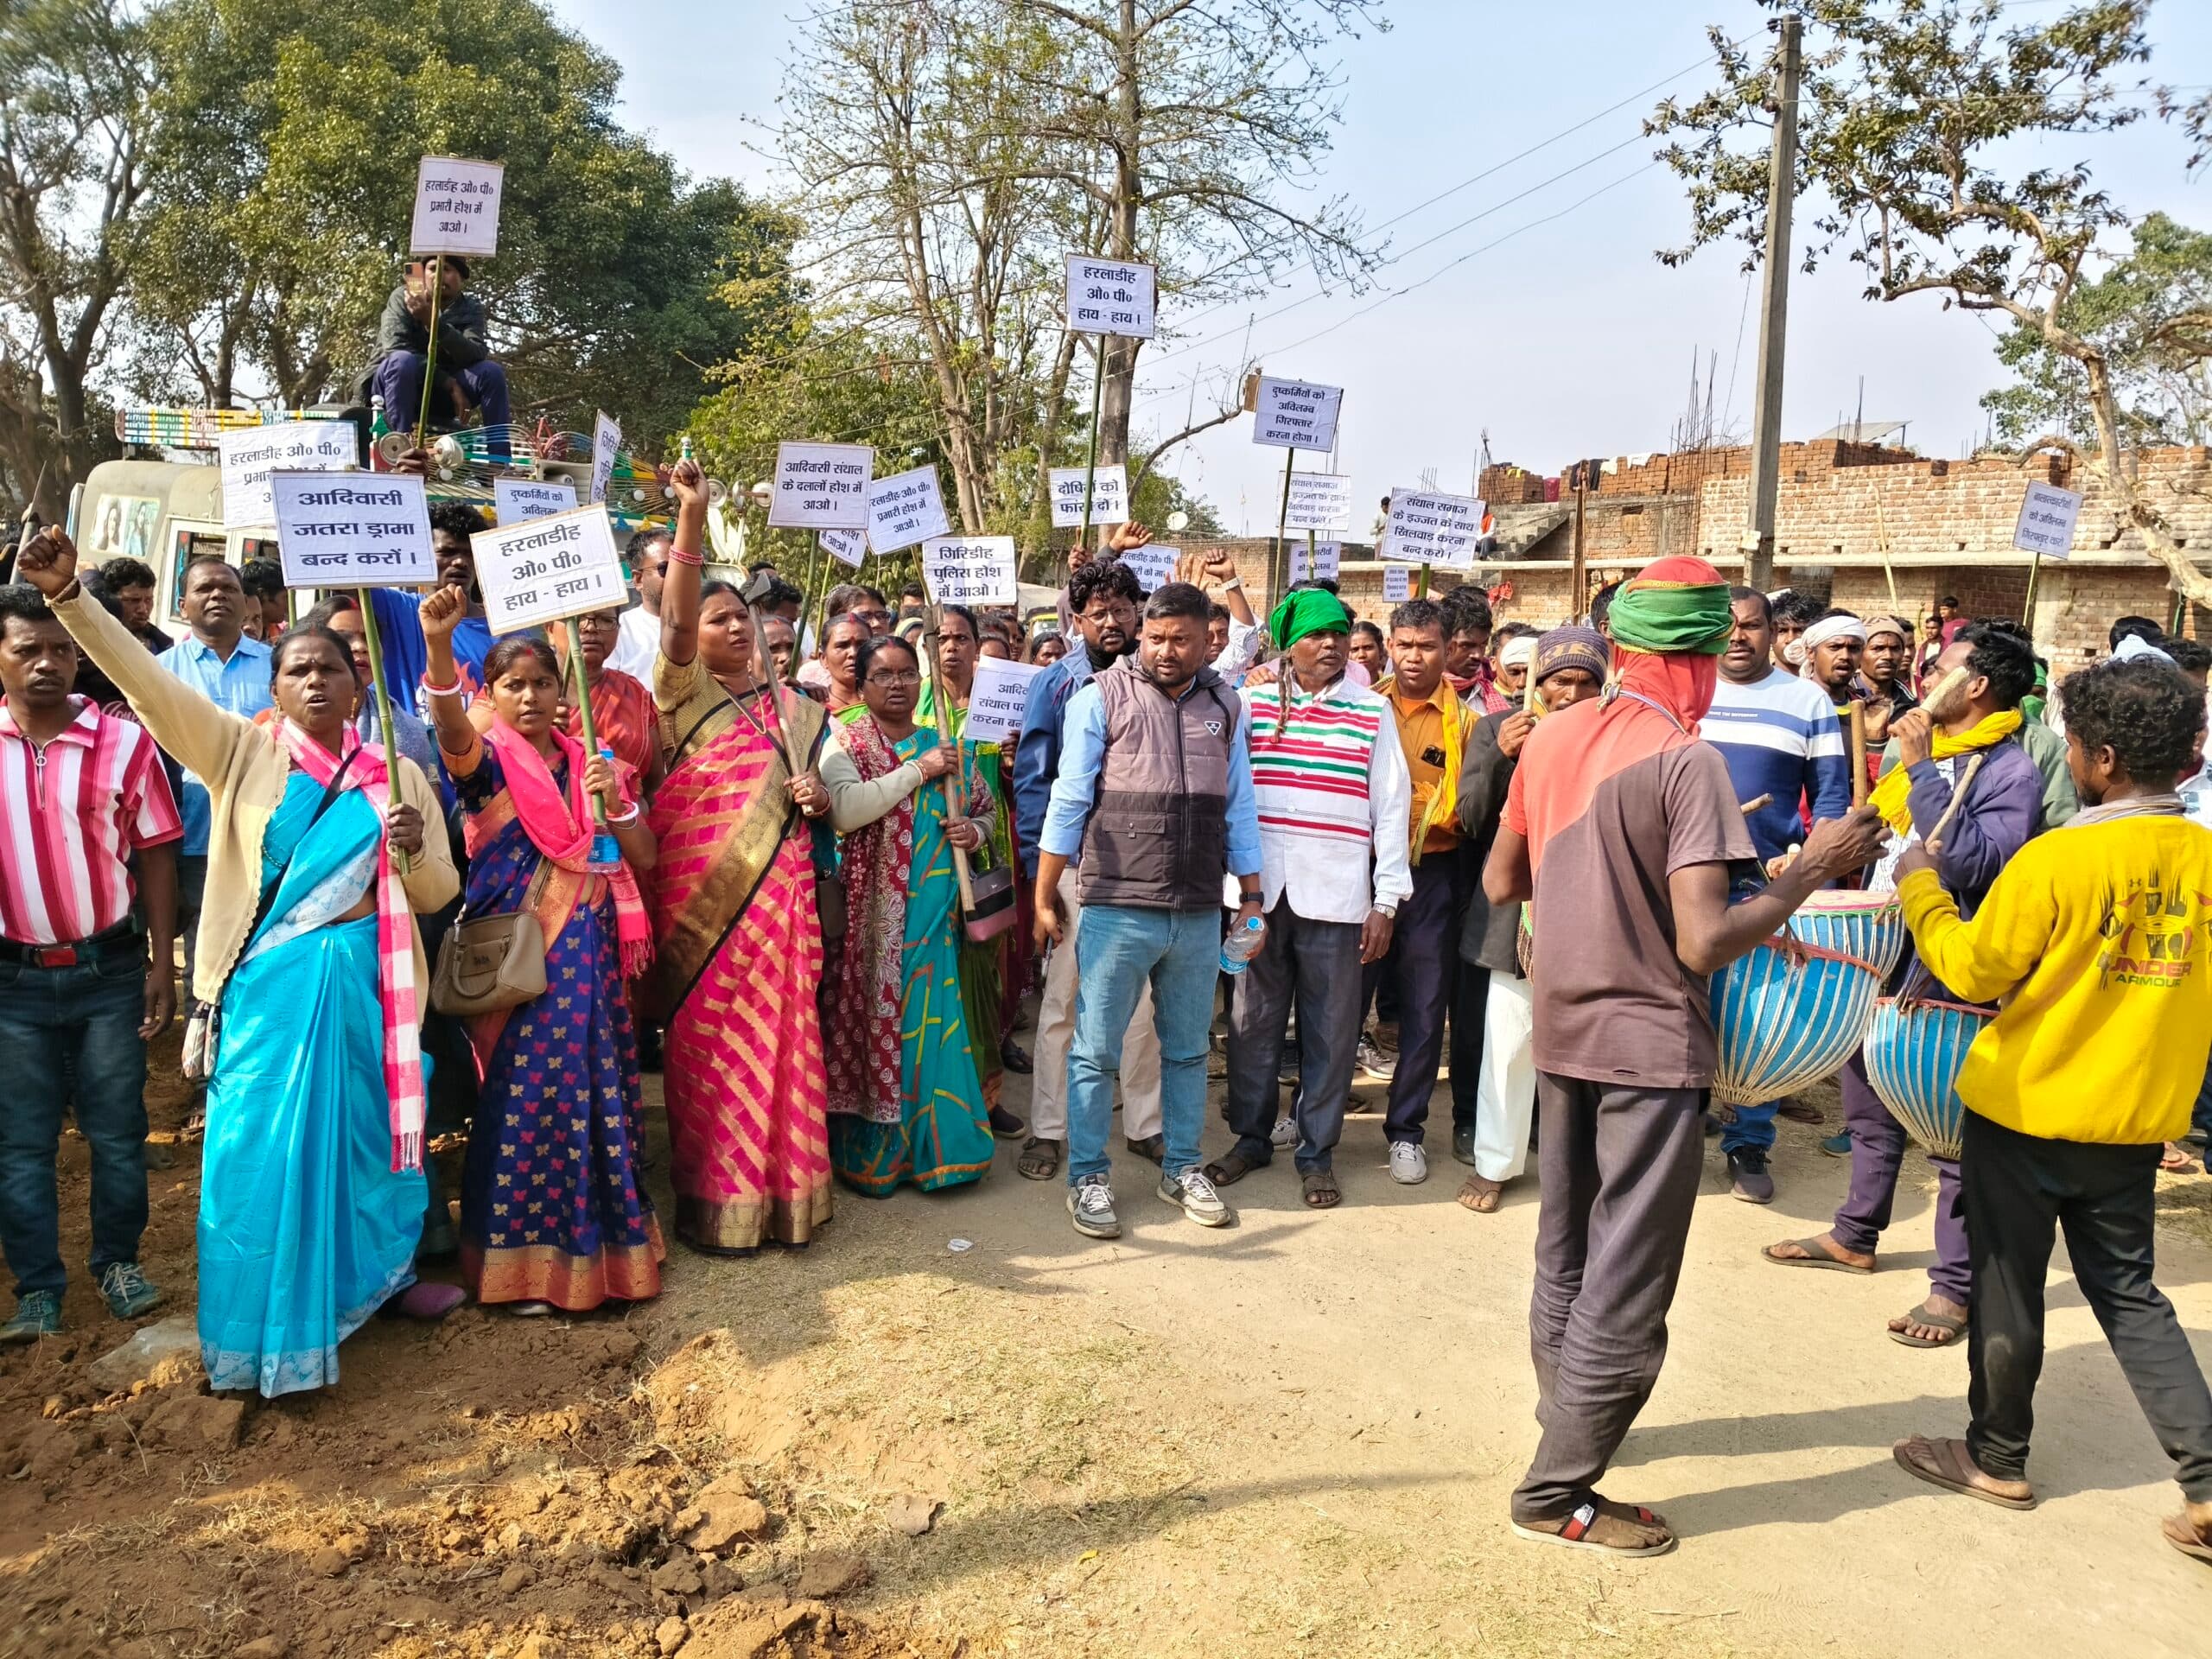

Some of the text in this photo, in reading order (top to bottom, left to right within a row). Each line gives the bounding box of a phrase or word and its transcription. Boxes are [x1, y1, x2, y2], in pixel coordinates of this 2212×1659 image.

[429, 198, 483, 214] प्रभारी होश में
[1084, 266, 1136, 284] हरलाडीह
[1078, 308, 1099, 320] हाय
[1111, 311, 1132, 324] हाय
[1272, 386, 1325, 400] दुष्कर्मियों को
[1279, 401, 1315, 413] अविलम्ब
[1275, 414, 1313, 428] गिरफ्तार
[1266, 429, 1290, 440] करना
[1293, 431, 1312, 442] होगा
[229, 446, 282, 465] हरलाडीह
[785, 460, 863, 475] आदिवासी संथाल
[782, 479, 863, 493] के दलालों होश में
[1100, 479, 1119, 492] को
[299, 489, 402, 505] आदिवासी
[552, 491, 563, 502] को
[869, 491, 900, 507] रलाडीह
[803, 499, 830, 510] आओ
[877, 498, 926, 522] प्रभारी होश में
[1098, 499, 1110, 511] दो
[1407, 496, 1468, 515] संथाल समाज
[1393, 510, 1475, 531] के इज्जत के साथ
[2029, 510, 2039, 521] को
[292, 522, 415, 538] जतरा ड्रामा
[893, 518, 915, 533] आओ
[499, 524, 582, 557] हरलाडीह
[1395, 525, 1466, 546] खिलवाड़ करना
[300, 553, 349, 566] बन्द
[356, 549, 401, 565] करों
[939, 546, 993, 560] गिरिडीह
[1402, 544, 1421, 555] बन्द
[1424, 547, 1445, 558] करो
[934, 566, 1001, 583] पुलिस होश
[1144, 567, 1153, 576] को
[1297, 563, 1306, 572] को
[504, 589, 537, 611] हाय
[554, 577, 589, 598] हाय
[938, 585, 950, 598] में
[954, 583, 988, 597] आओ
[979, 696, 1011, 710] संथाल
[973, 713, 1004, 726] करना
